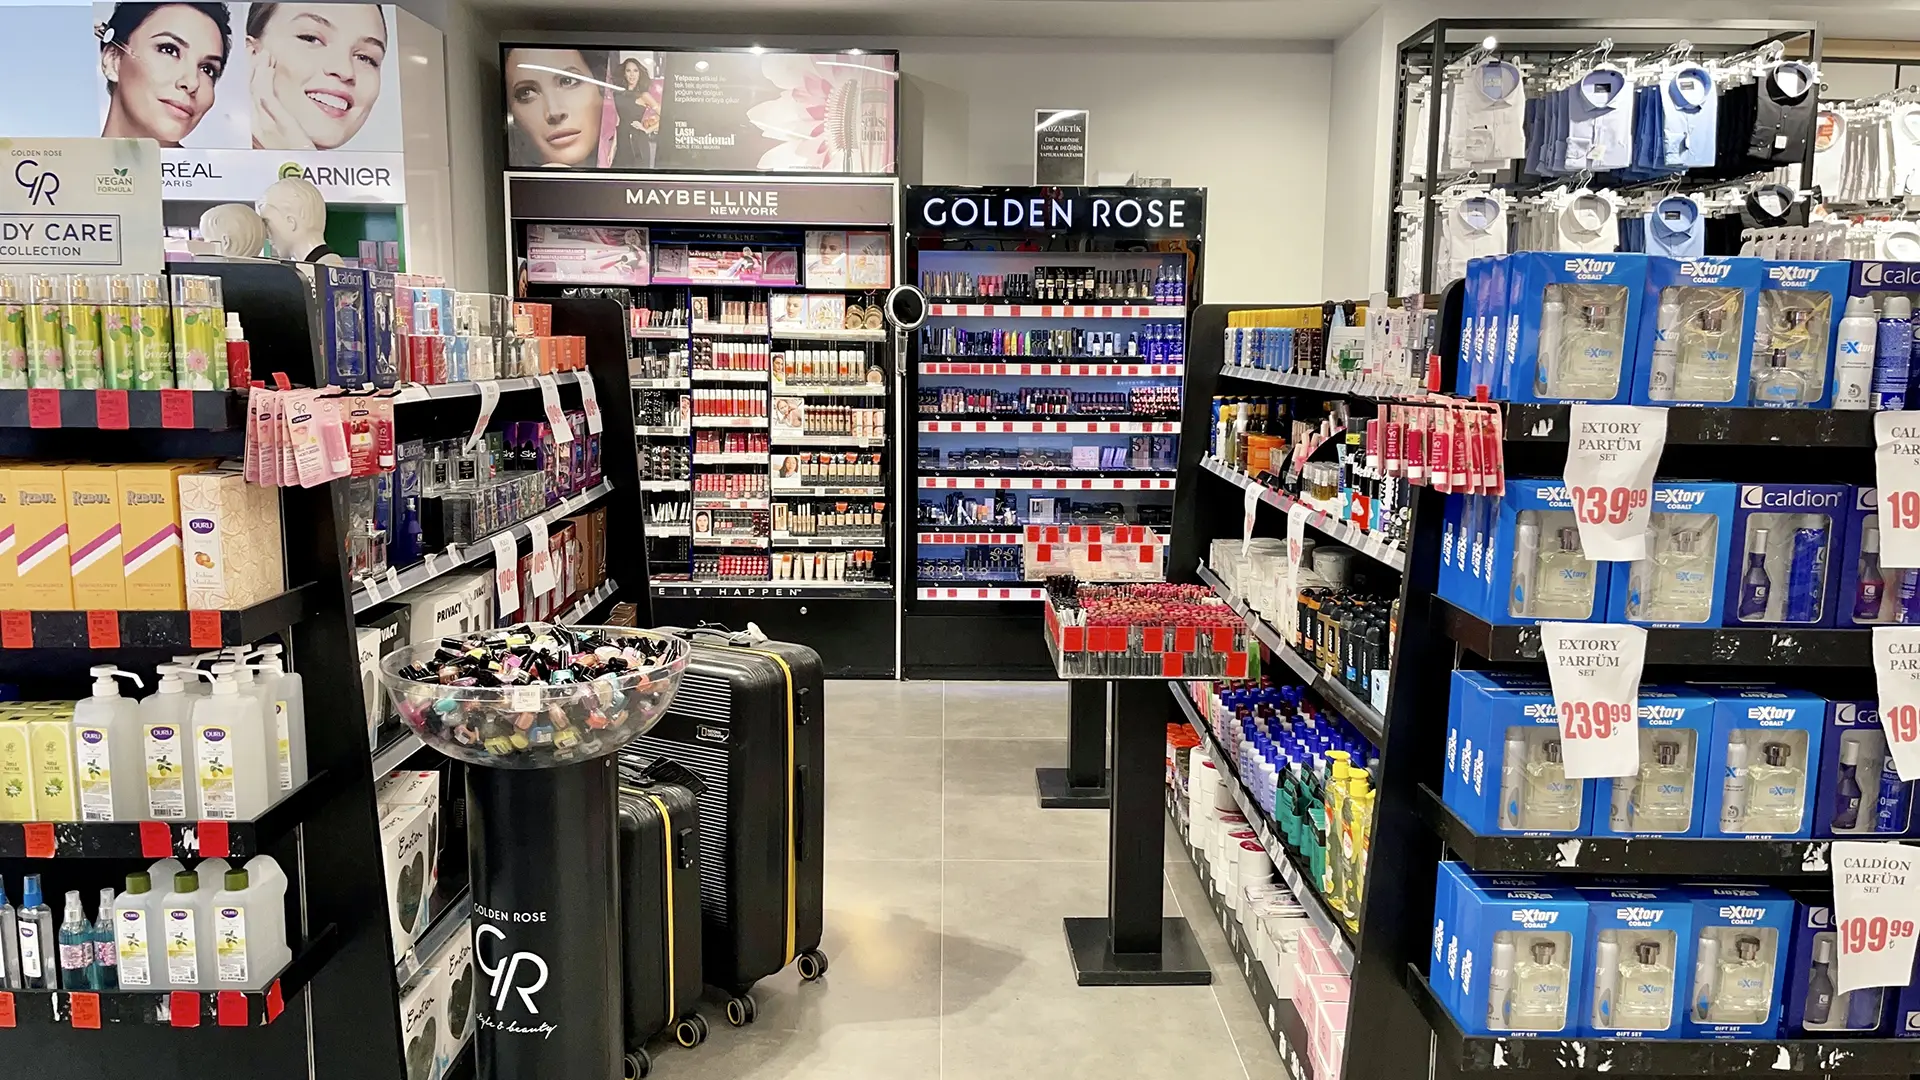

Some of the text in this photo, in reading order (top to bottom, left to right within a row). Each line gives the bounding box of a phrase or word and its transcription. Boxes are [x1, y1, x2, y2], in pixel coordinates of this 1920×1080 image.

[675, 128, 695, 136] LASH
[675, 133, 735, 146] sensational
[97, 176, 132, 186] VEGAN
[626, 188, 778, 206] MAYBELLINE
[710, 207, 778, 216] NEW YORK
[923, 198, 1185, 228] GOLDEN ROSE
[45, 224, 112, 241] CARE
[1581, 422, 1642, 434] EXTORY
[1578, 439, 1642, 451] PARFÜM
[520, 450, 537, 458] She
[1764, 490, 1838, 507] caldion
[436, 602, 462, 623] PRIVACY
[1559, 639, 1620, 652] EXTORY
[1559, 654, 1620, 667] PARFÜM
[1578, 669, 1596, 677] SET
[83, 732, 100, 740] DURU
[1844, 856, 1912, 871] CALDİON
[1845, 872, 1906, 886] PARFÜM
[1863, 886, 1881, 894] SET
[474, 902, 547, 922] GOLDEN ROSE
[506, 1021, 558, 1040] beauty
